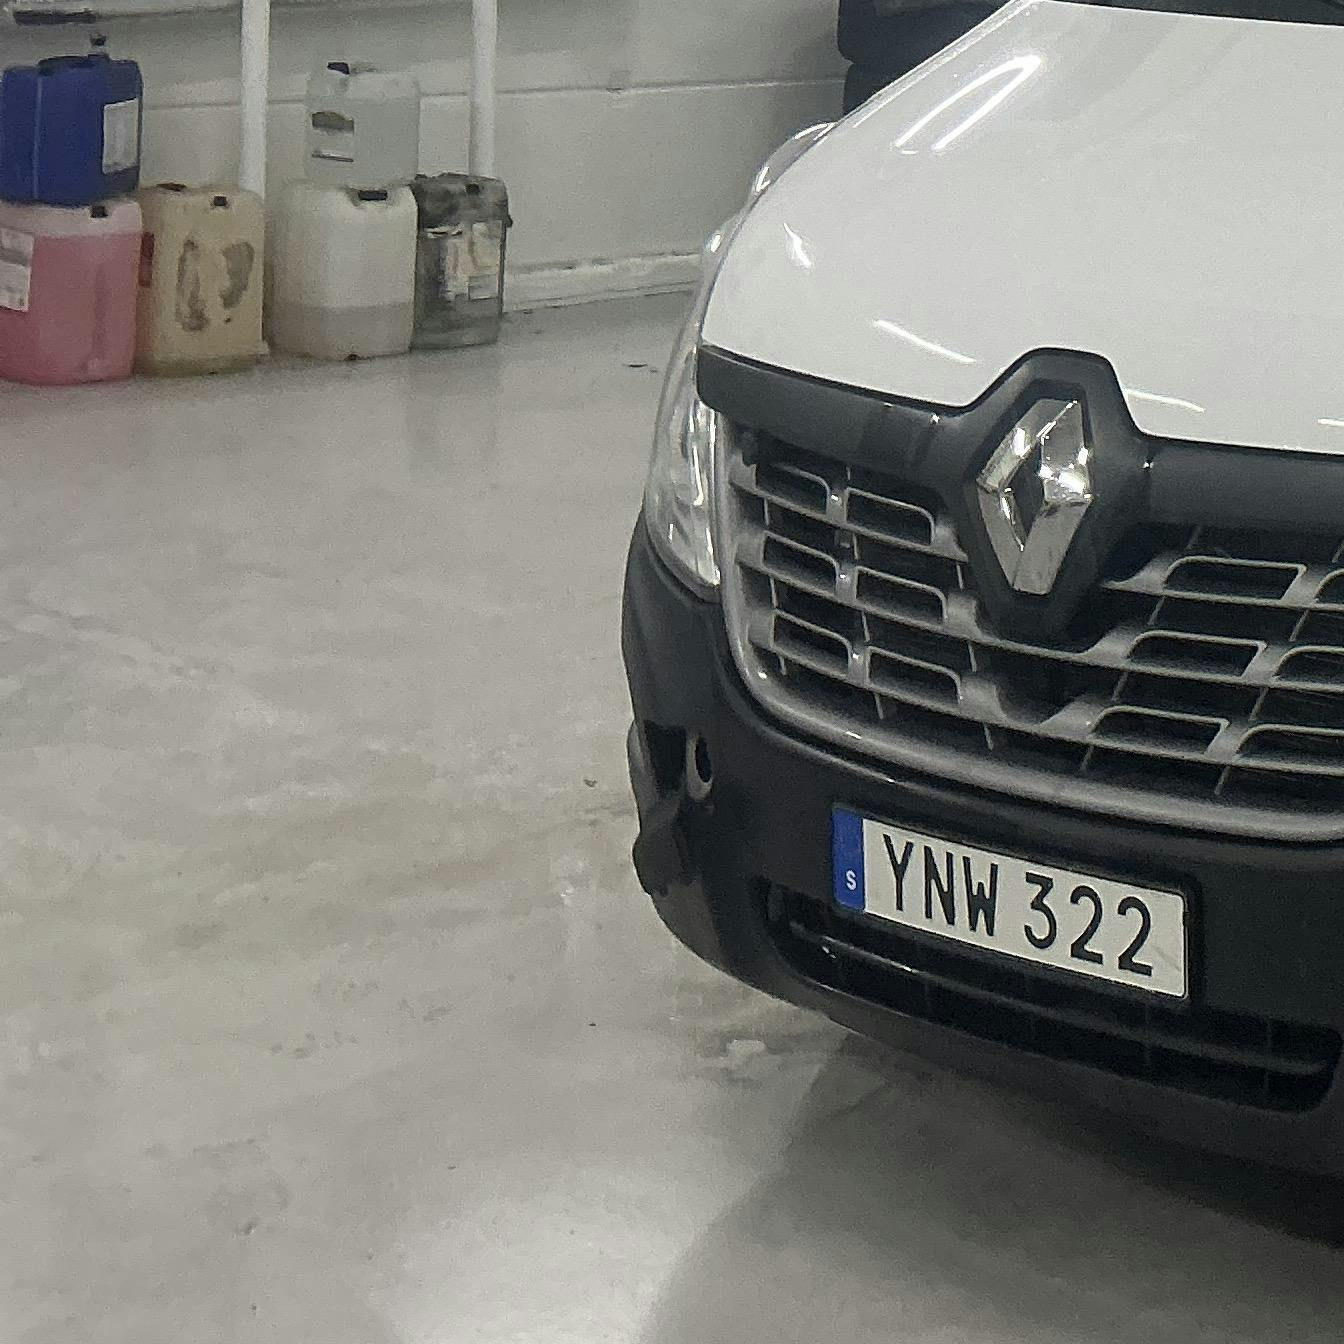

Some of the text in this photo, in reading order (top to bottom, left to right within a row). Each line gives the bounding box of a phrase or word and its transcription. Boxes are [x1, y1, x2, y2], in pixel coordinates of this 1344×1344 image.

[845, 834, 1152, 976] S YNW 322
